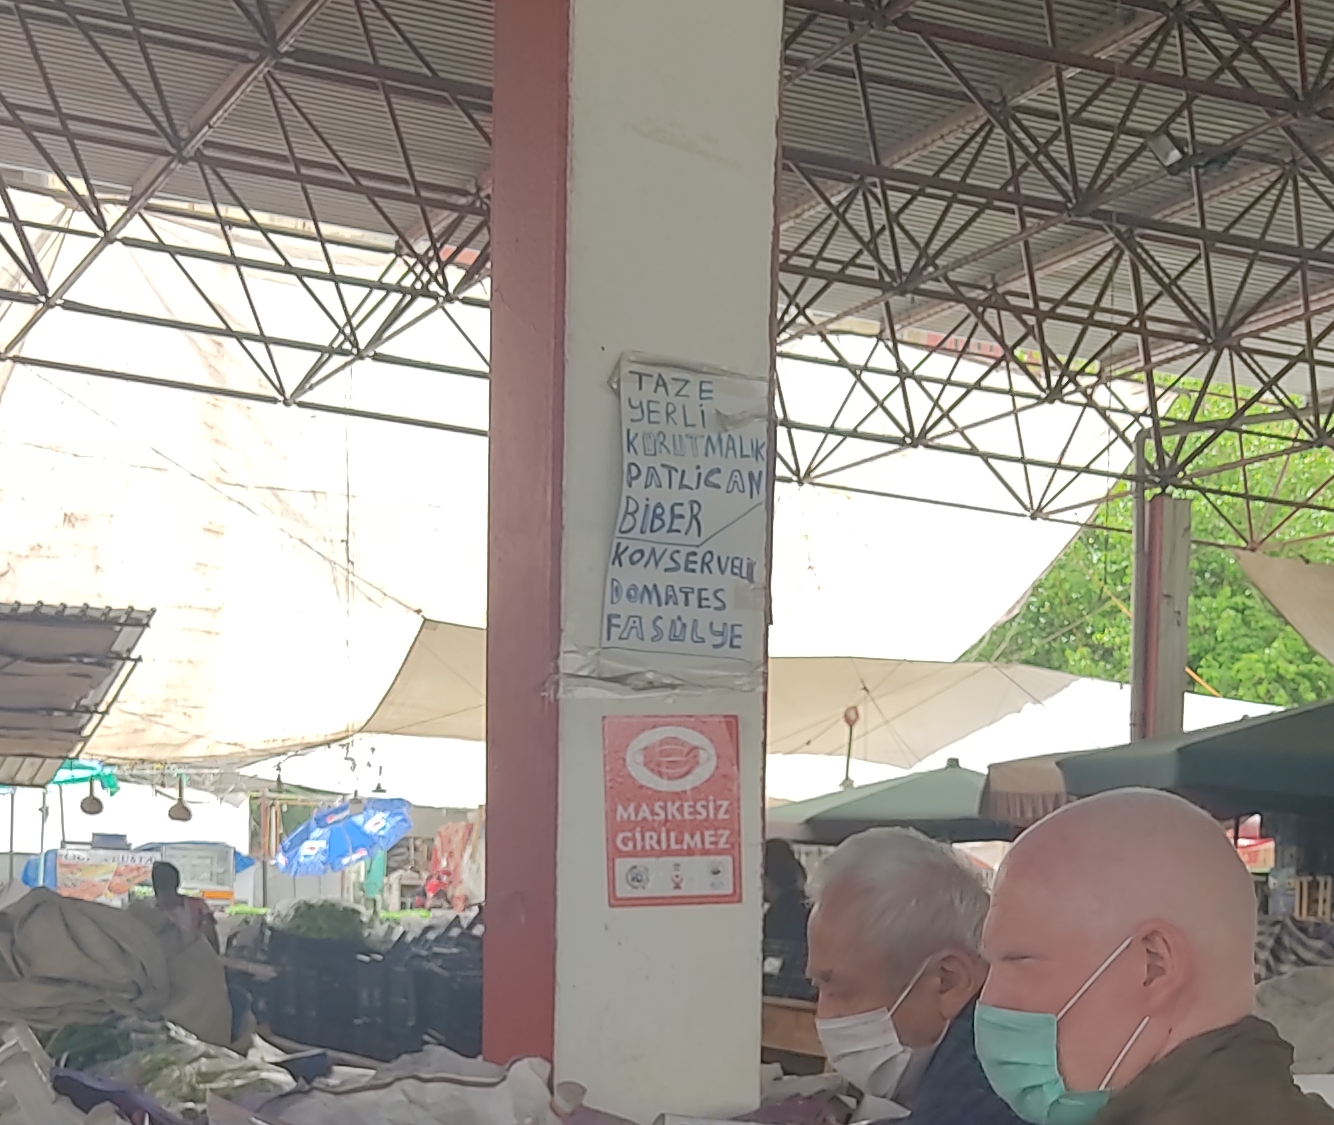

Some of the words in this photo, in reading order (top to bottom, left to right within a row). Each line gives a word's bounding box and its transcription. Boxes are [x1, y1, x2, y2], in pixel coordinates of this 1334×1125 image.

[628, 370, 714, 401] TAZE
[610, 578, 726, 611] DOMATES
[616, 795, 730, 821] MASKESİZ
[616, 826, 732, 851] GİRİLMEZ
